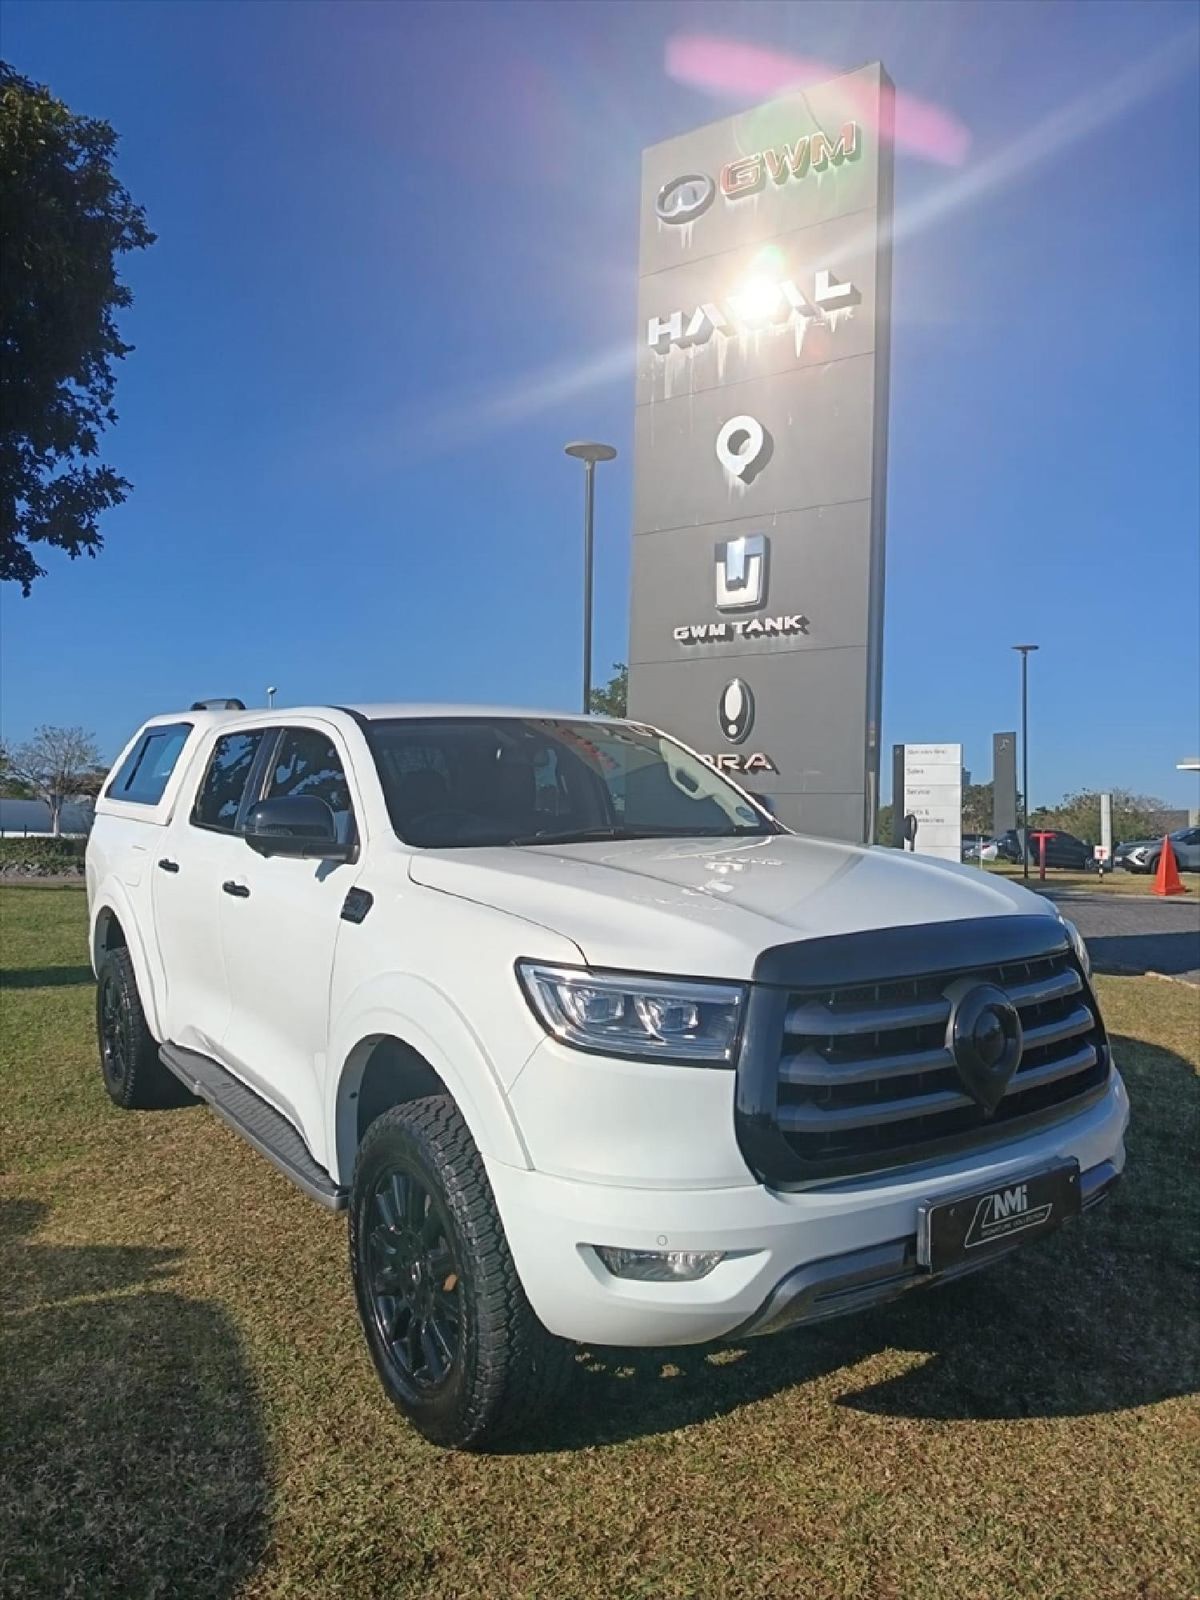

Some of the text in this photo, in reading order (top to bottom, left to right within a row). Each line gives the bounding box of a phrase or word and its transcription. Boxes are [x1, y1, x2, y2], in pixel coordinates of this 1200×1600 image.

[719, 120, 858, 198] GWM
[648, 269, 852, 346] HAAL
[673, 614, 802, 640] GWM TANK
